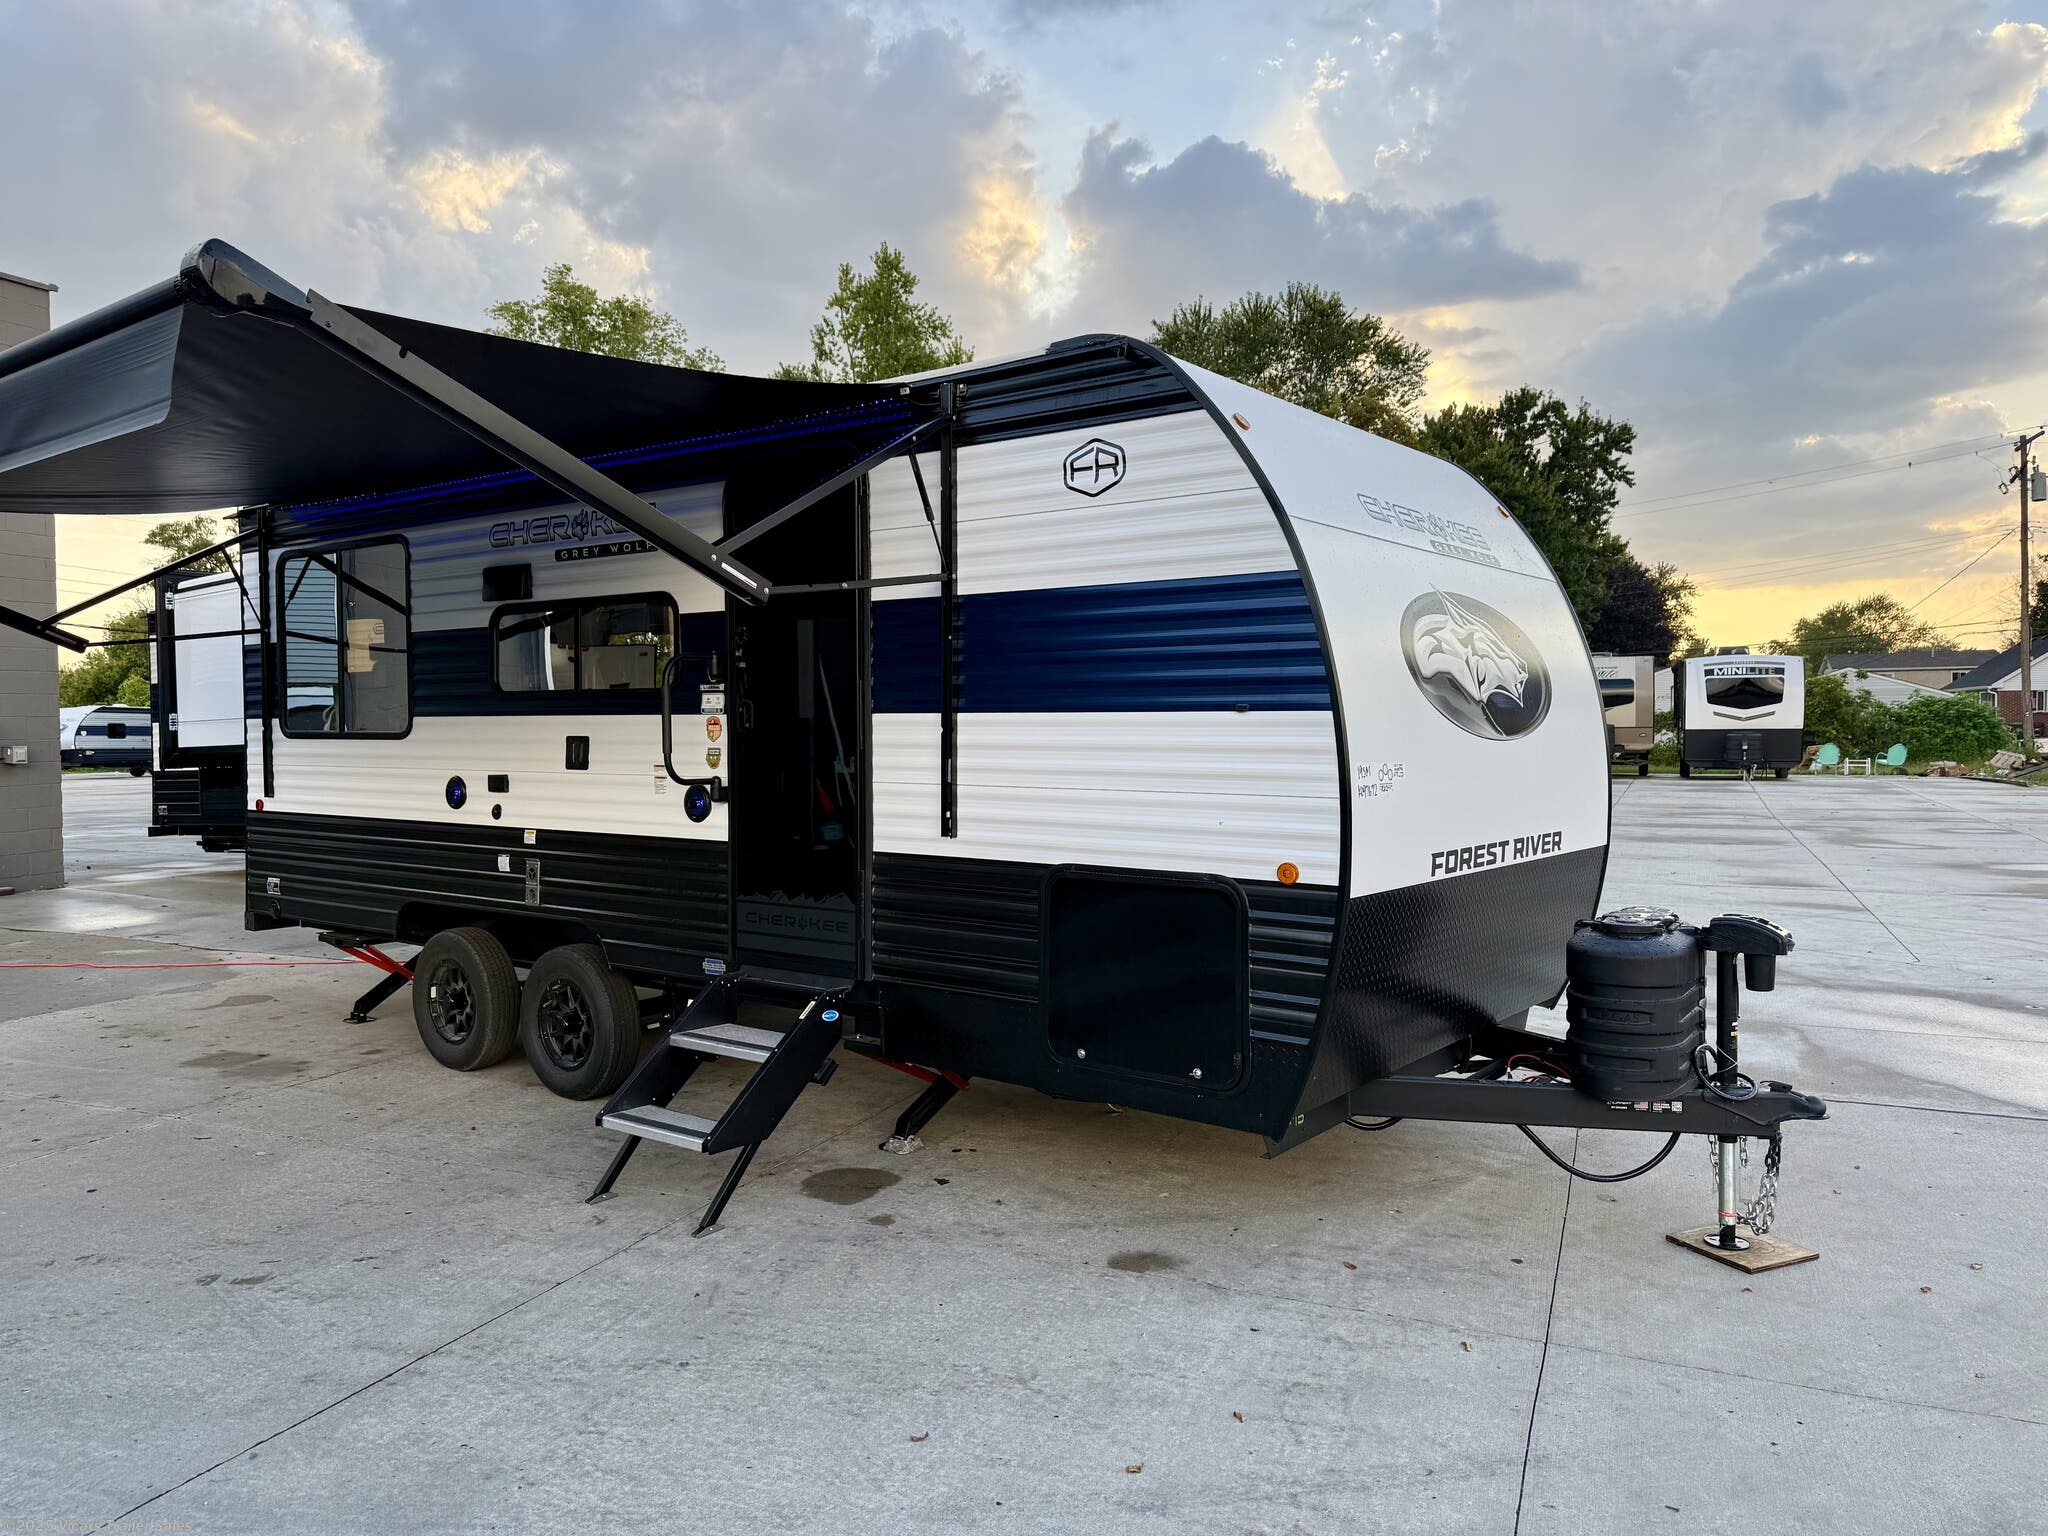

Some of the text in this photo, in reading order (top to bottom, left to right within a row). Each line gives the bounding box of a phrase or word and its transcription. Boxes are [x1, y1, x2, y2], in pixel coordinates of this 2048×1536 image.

[561, 542, 652, 559] GREY WOLF
[1431, 831, 1562, 877] FOREST RIVER
